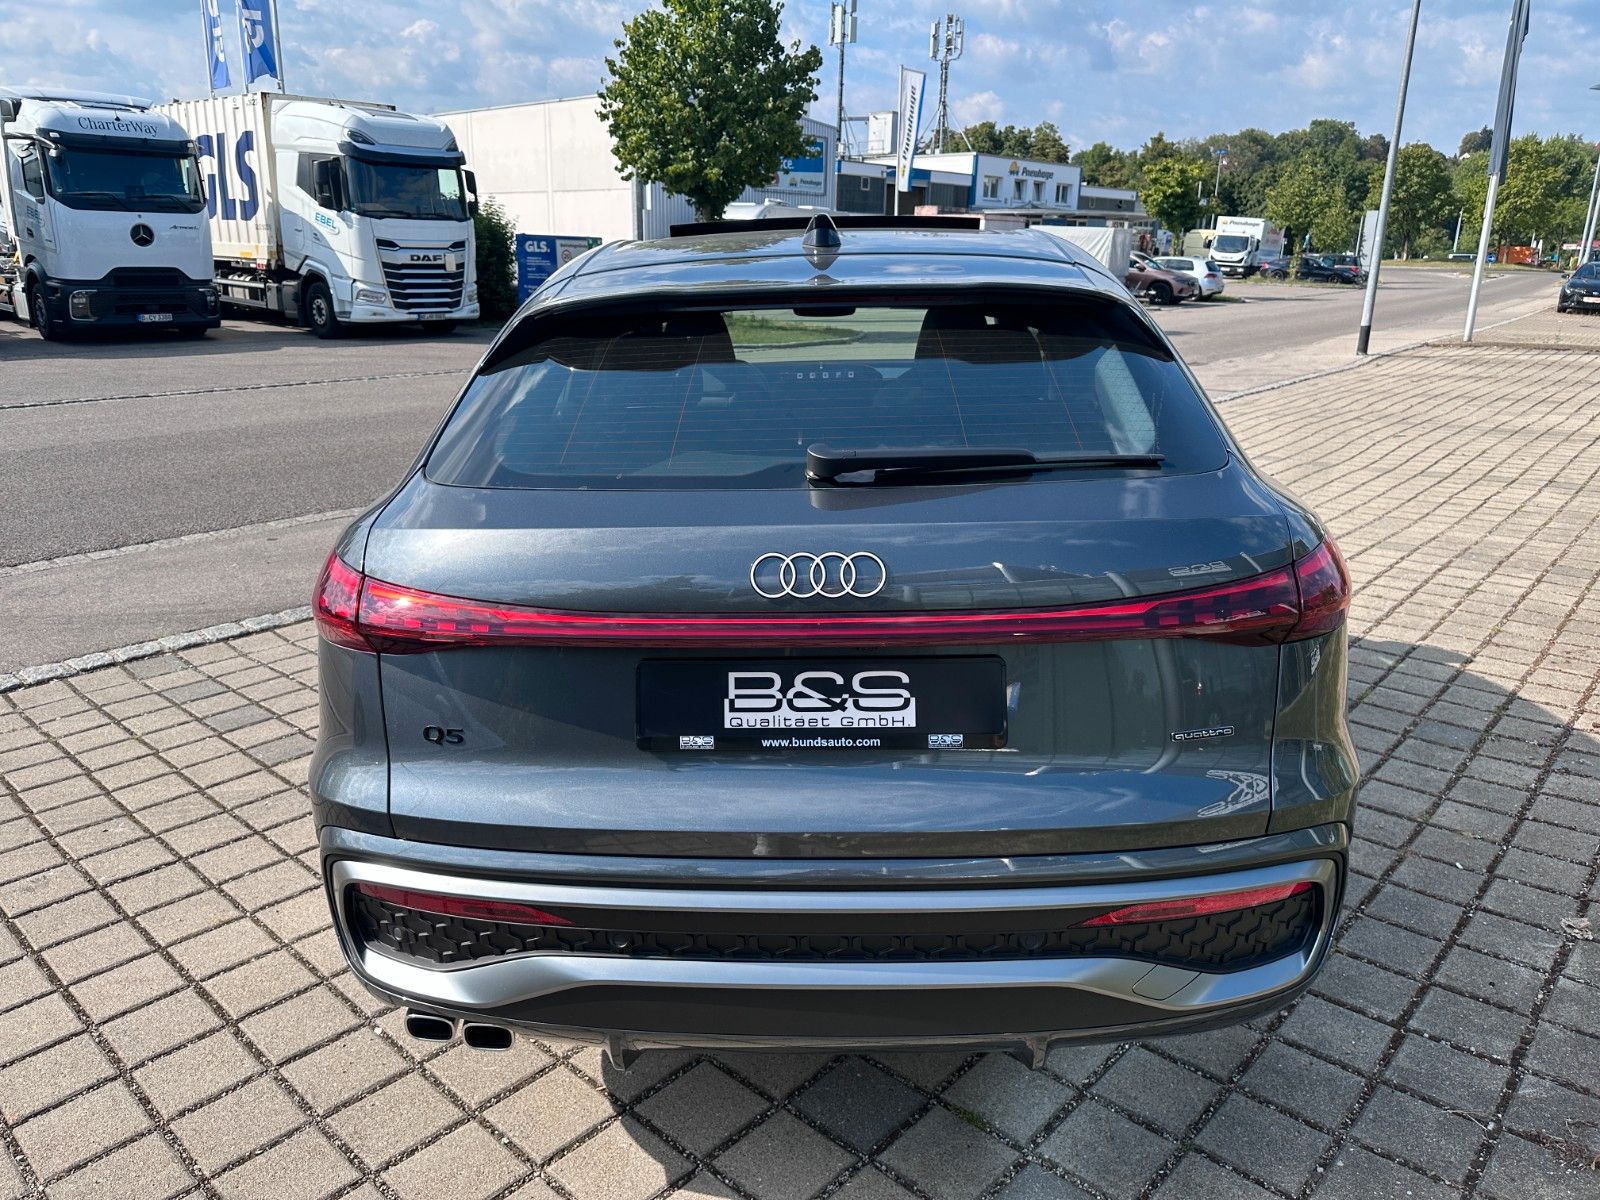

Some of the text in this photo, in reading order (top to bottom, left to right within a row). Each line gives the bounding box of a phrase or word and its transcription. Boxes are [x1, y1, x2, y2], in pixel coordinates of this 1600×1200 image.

[78, 117, 158, 137] CharterWay
[196, 130, 260, 222] GLS
[315, 211, 337, 230] EBEL
[410, 254, 443, 262] DAF
[727, 671, 912, 712] B&S
[729, 714, 831, 728] Qualitaet
[422, 725, 465, 746] Q5
[680, 736, 714, 746] B&S
[929, 734, 963, 745] B&S
[1174, 727, 1233, 741] quattro
[761, 736, 881, 747] www.bundsauto.com
